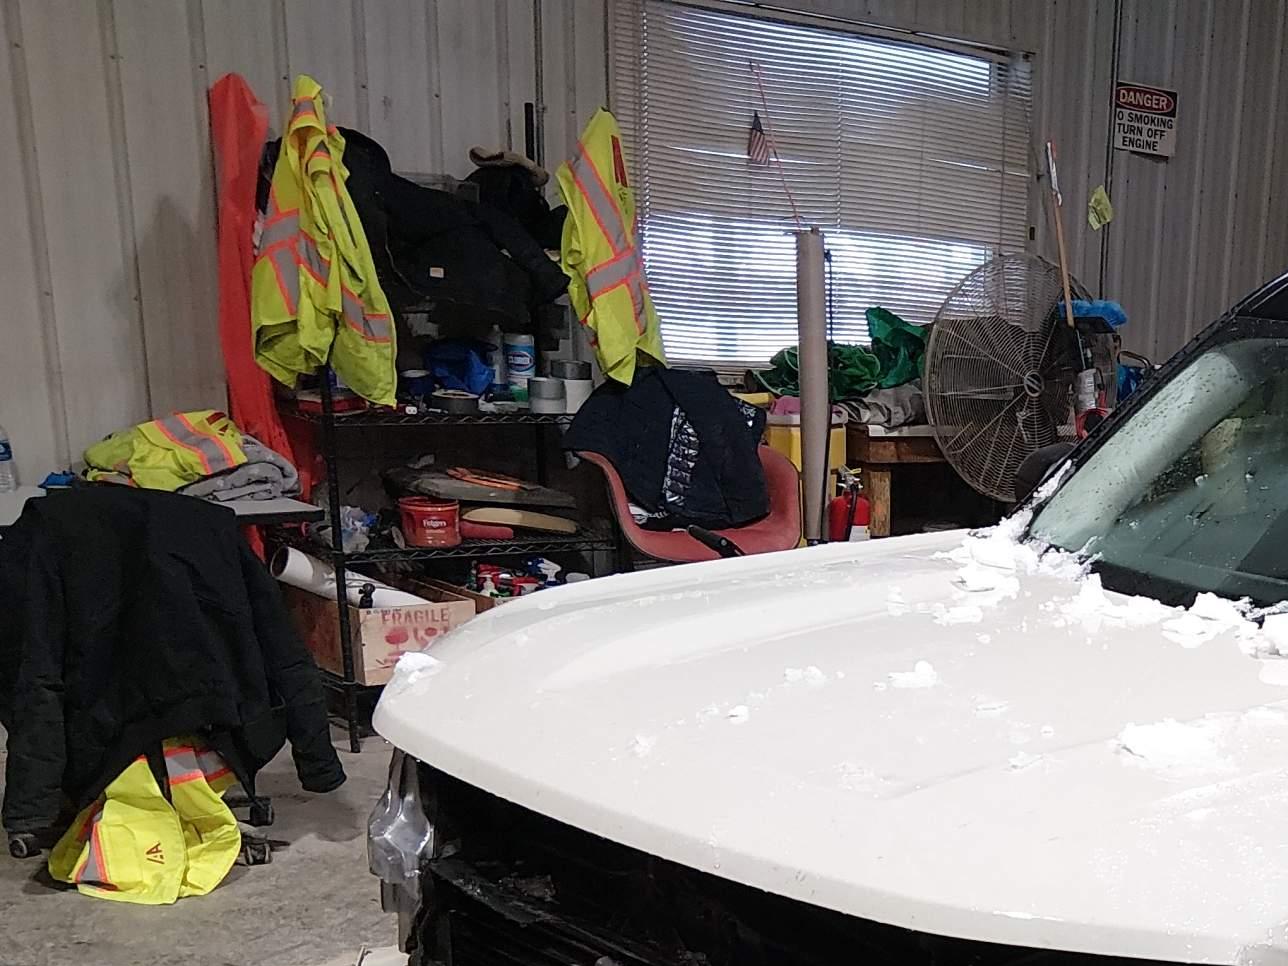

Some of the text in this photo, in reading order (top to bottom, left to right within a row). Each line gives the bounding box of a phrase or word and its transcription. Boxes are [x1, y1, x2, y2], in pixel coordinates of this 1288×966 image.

[1119, 89, 1168, 110] DANGER
[1117, 110, 1173, 130] O SMOKING
[1117, 122, 1167, 140] TURN OFF
[1121, 135, 1159, 152] ENGINE
[381, 606, 449, 625] FRAGILE
